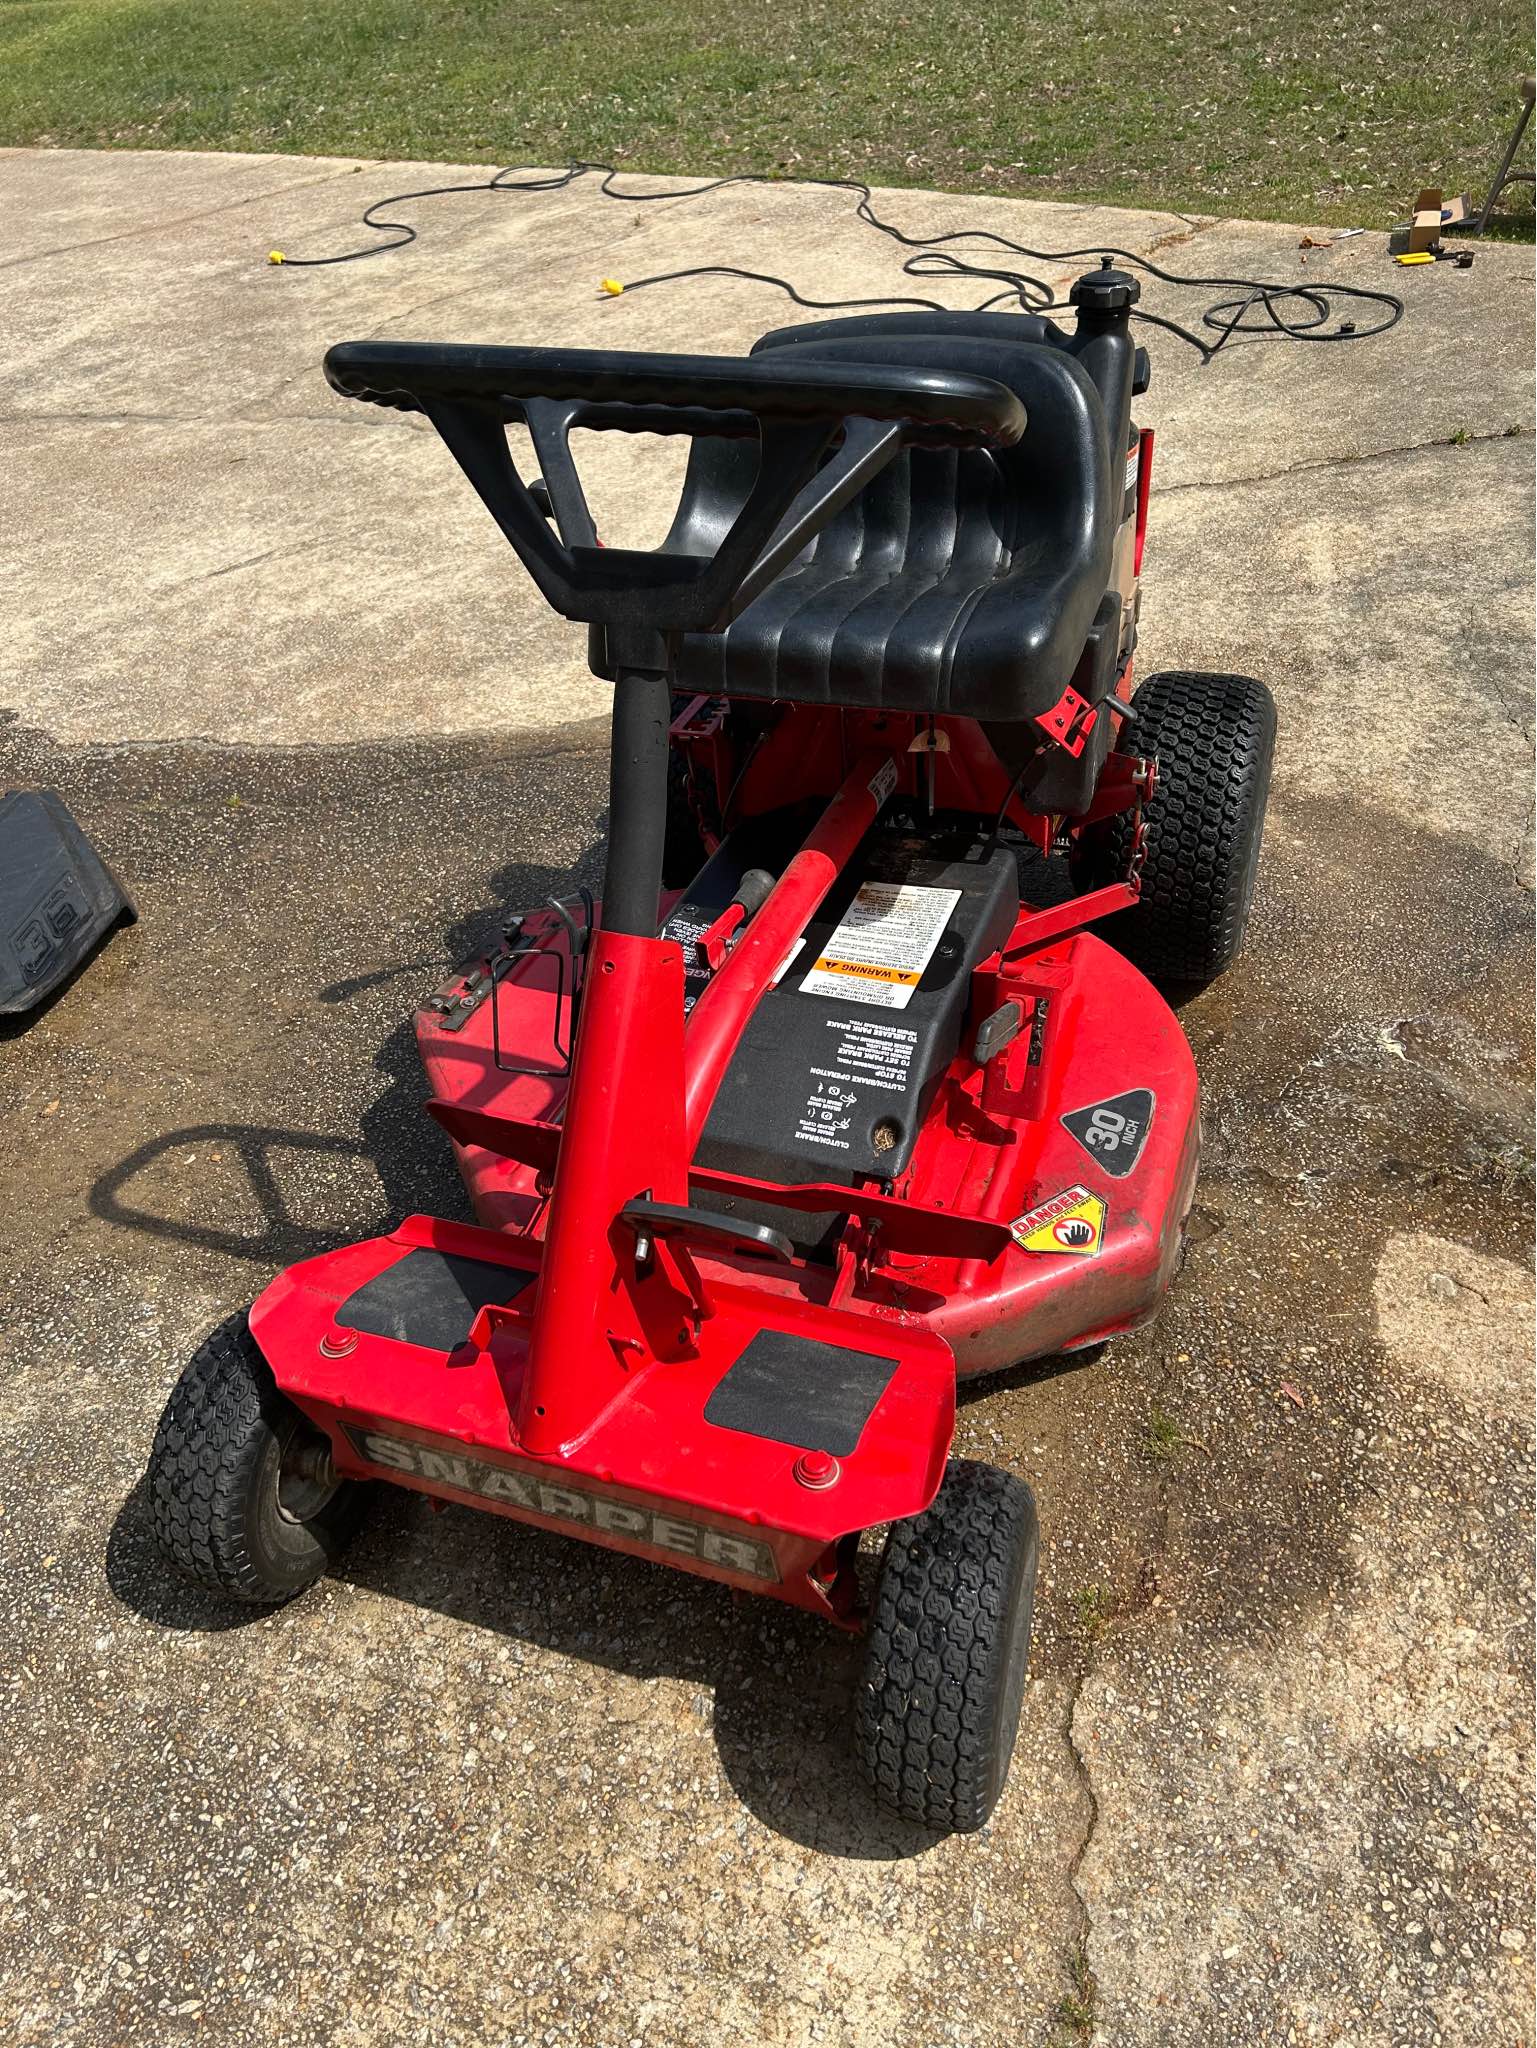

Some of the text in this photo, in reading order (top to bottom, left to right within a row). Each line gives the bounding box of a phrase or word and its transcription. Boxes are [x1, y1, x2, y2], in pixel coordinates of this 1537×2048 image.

[842, 964, 892, 978] WARNING
[826, 1020, 851, 1030] BRAKE
[852, 1024, 872, 1034] PARK
[873, 1028, 906, 1040] RELEASE
[838, 1048, 862, 1057] BRAKE
[864, 1052, 883, 1061] PARK
[810, 1067, 905, 1091] CLUTCH/BRAKE OPERATION
[875, 1070, 895, 1079] STOP
[1085, 1109, 1126, 1151] 30
[1122, 1119, 1140, 1146] INCH
[795, 1131, 849, 1149] CLUTCH/BRAKE
[1012, 1190, 1085, 1235] DANGER
[364, 1434, 764, 1576] SNAPPER
